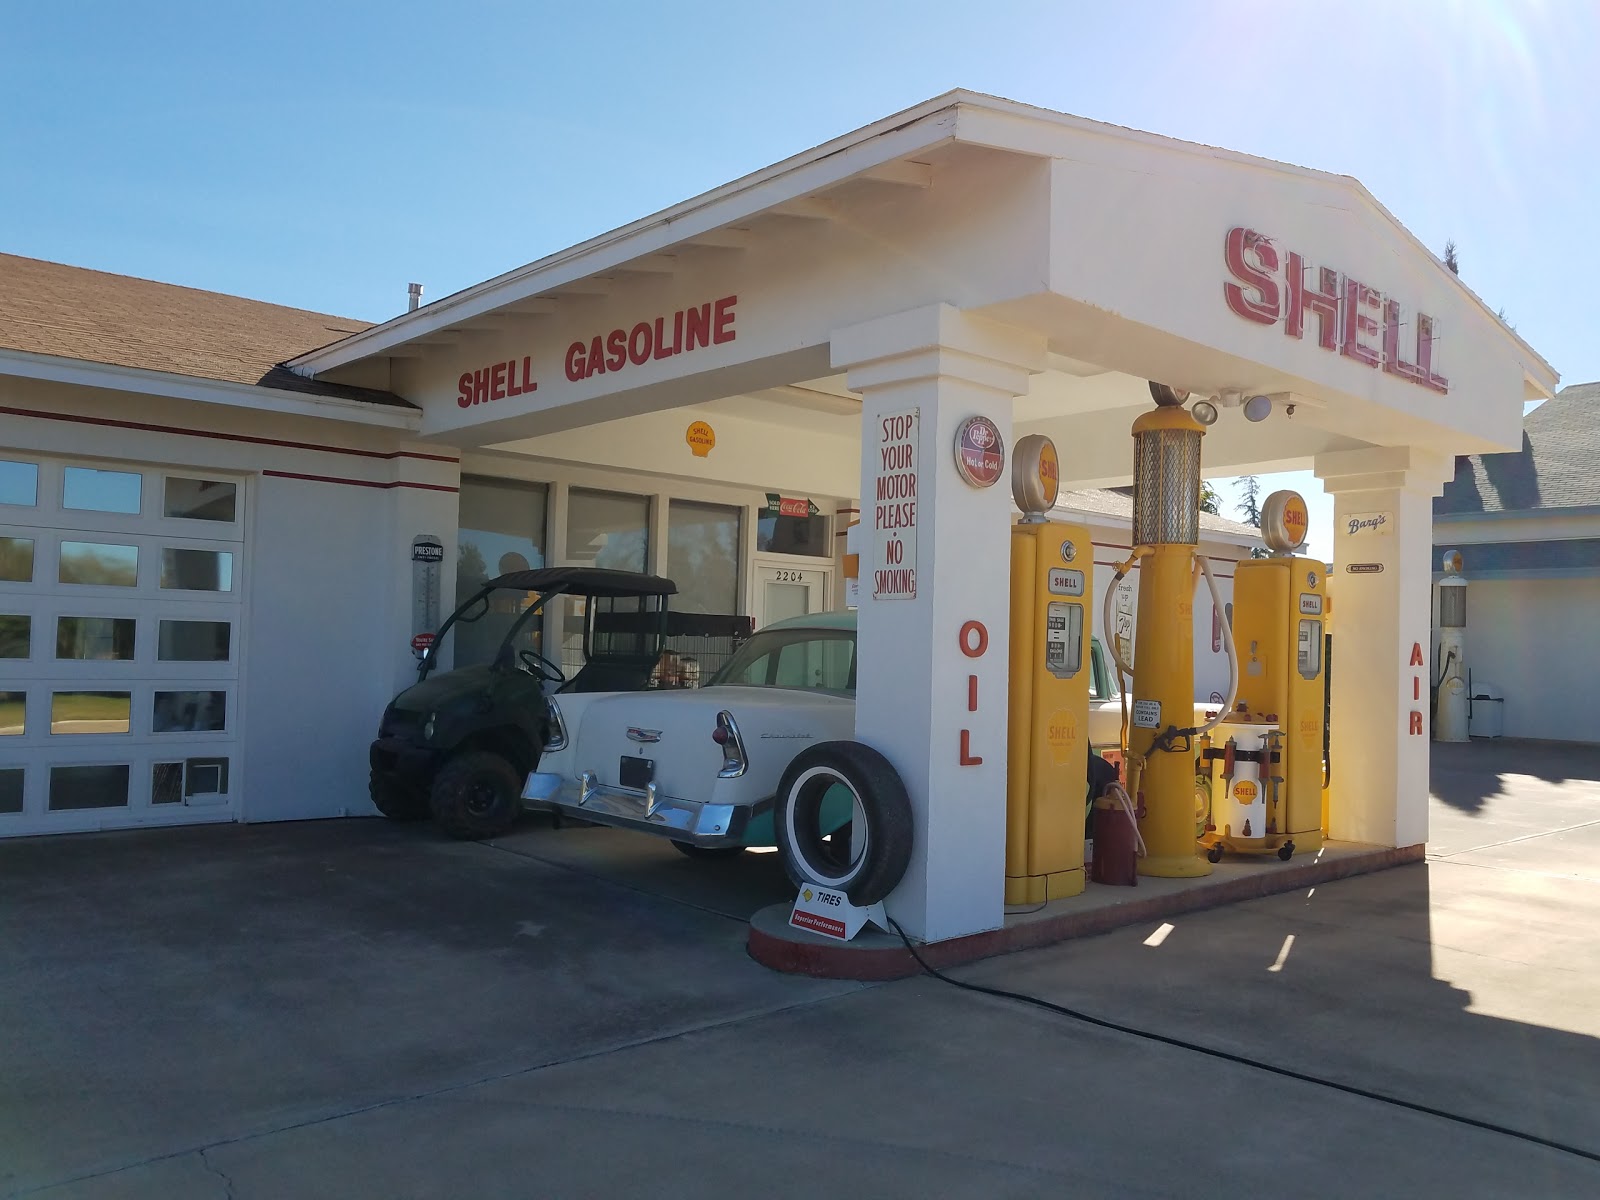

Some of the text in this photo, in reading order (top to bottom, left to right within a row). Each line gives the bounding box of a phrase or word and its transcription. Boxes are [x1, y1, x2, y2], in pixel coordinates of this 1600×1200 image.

[1223, 227, 1450, 396] SHELL
[457, 295, 737, 408] SHELL GASOLINE
[693, 428, 709, 437] SHELL
[882, 414, 913, 442] STOP
[689, 436, 713, 445] GASOLINE
[972, 429, 993, 445] Pepper
[881, 444, 913, 471] YOUR
[966, 456, 978, 467] Hot
[985, 459, 998, 470] Cold
[876, 473, 916, 501] MOTOR
[876, 503, 916, 530] PLEASE
[1347, 514, 1387, 535] Barq's
[414, 546, 442, 556] PRESTONE
[886, 540, 904, 565] NO
[776, 570, 803, 582] 2204
[874, 569, 915, 594] SMOKING
[1054, 577, 1077, 588] SHELL
[1118, 584, 1132, 592] fresh
[1303, 600, 1318, 609] SHELL
[959, 620, 989, 766] OIL
[1409, 642, 1424, 735] AIR
[1136, 709, 1158, 717] CONTAINS
[1049, 726, 1075, 740] SHELL
[1300, 720, 1319, 732] SHELL
[1235, 787, 1256, 796] SHELL
[817, 891, 842, 907] TIRES
[813, 919, 844, 933] Performance
